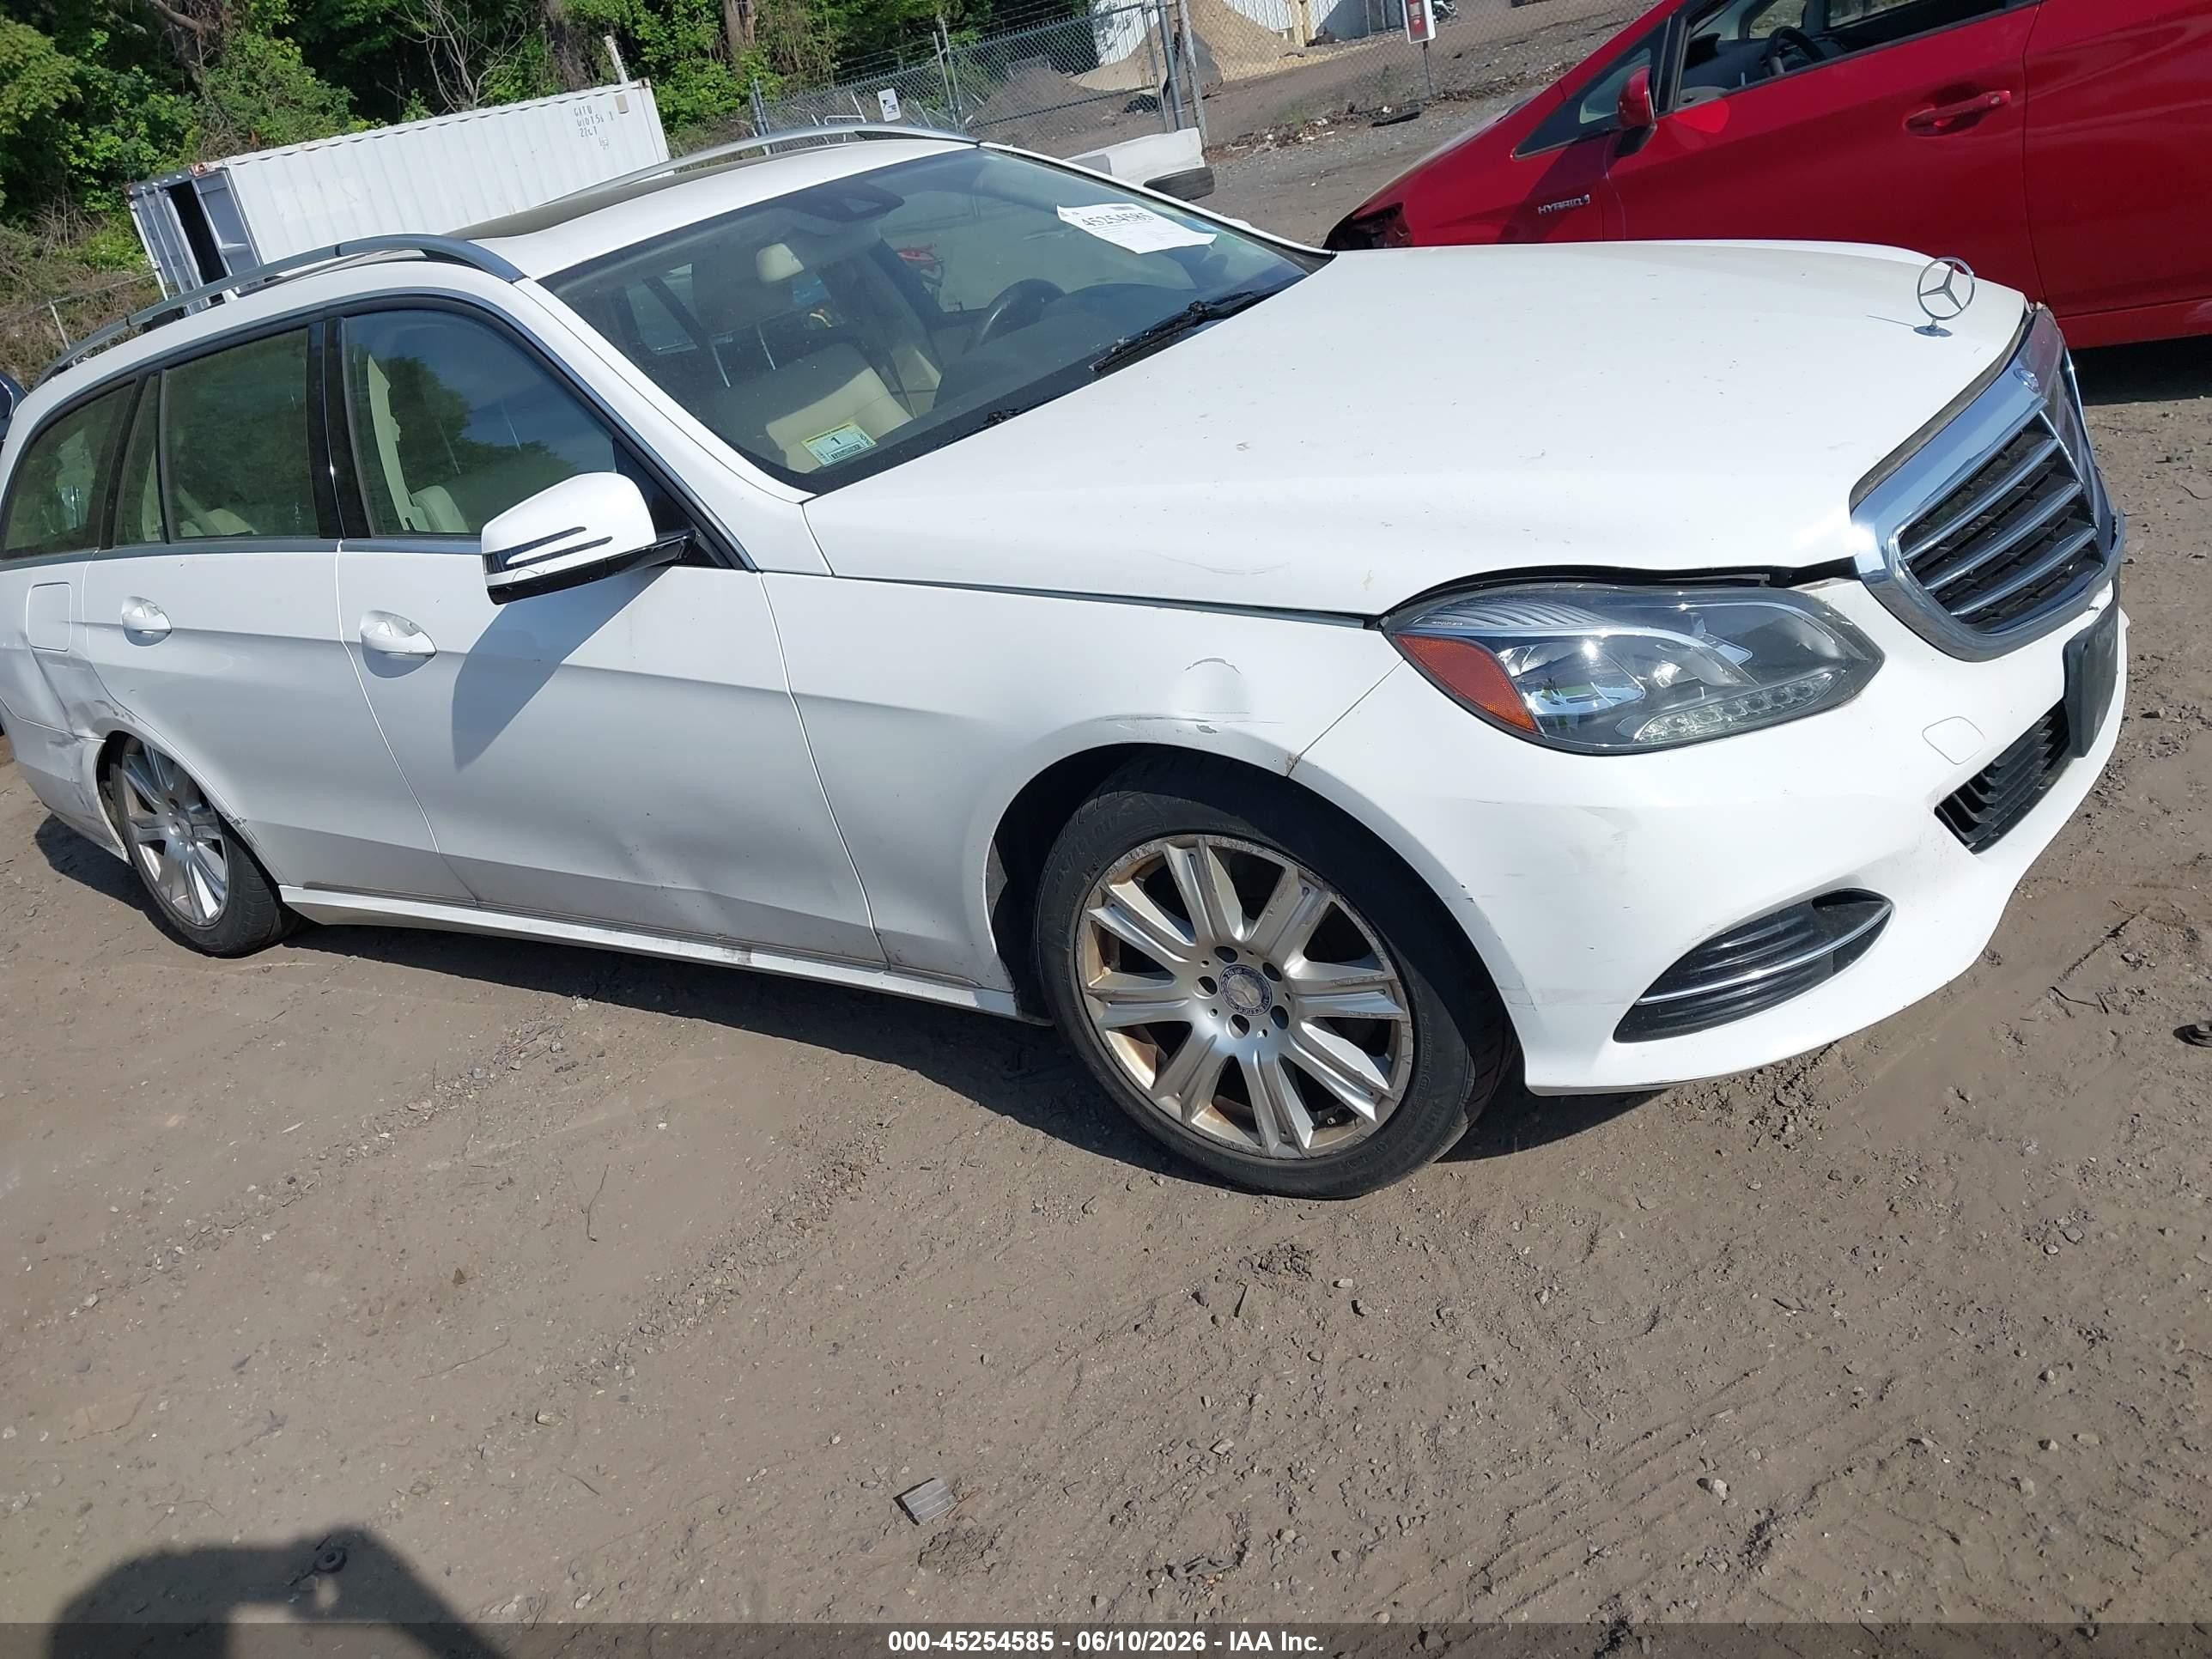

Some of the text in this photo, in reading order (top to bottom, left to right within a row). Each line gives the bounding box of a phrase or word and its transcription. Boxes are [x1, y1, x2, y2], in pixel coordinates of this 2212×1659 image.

[1538, 198, 1583, 215] HYBRID
[1081, 212, 1155, 226] 45254585
[829, 436, 842, 445] 1
